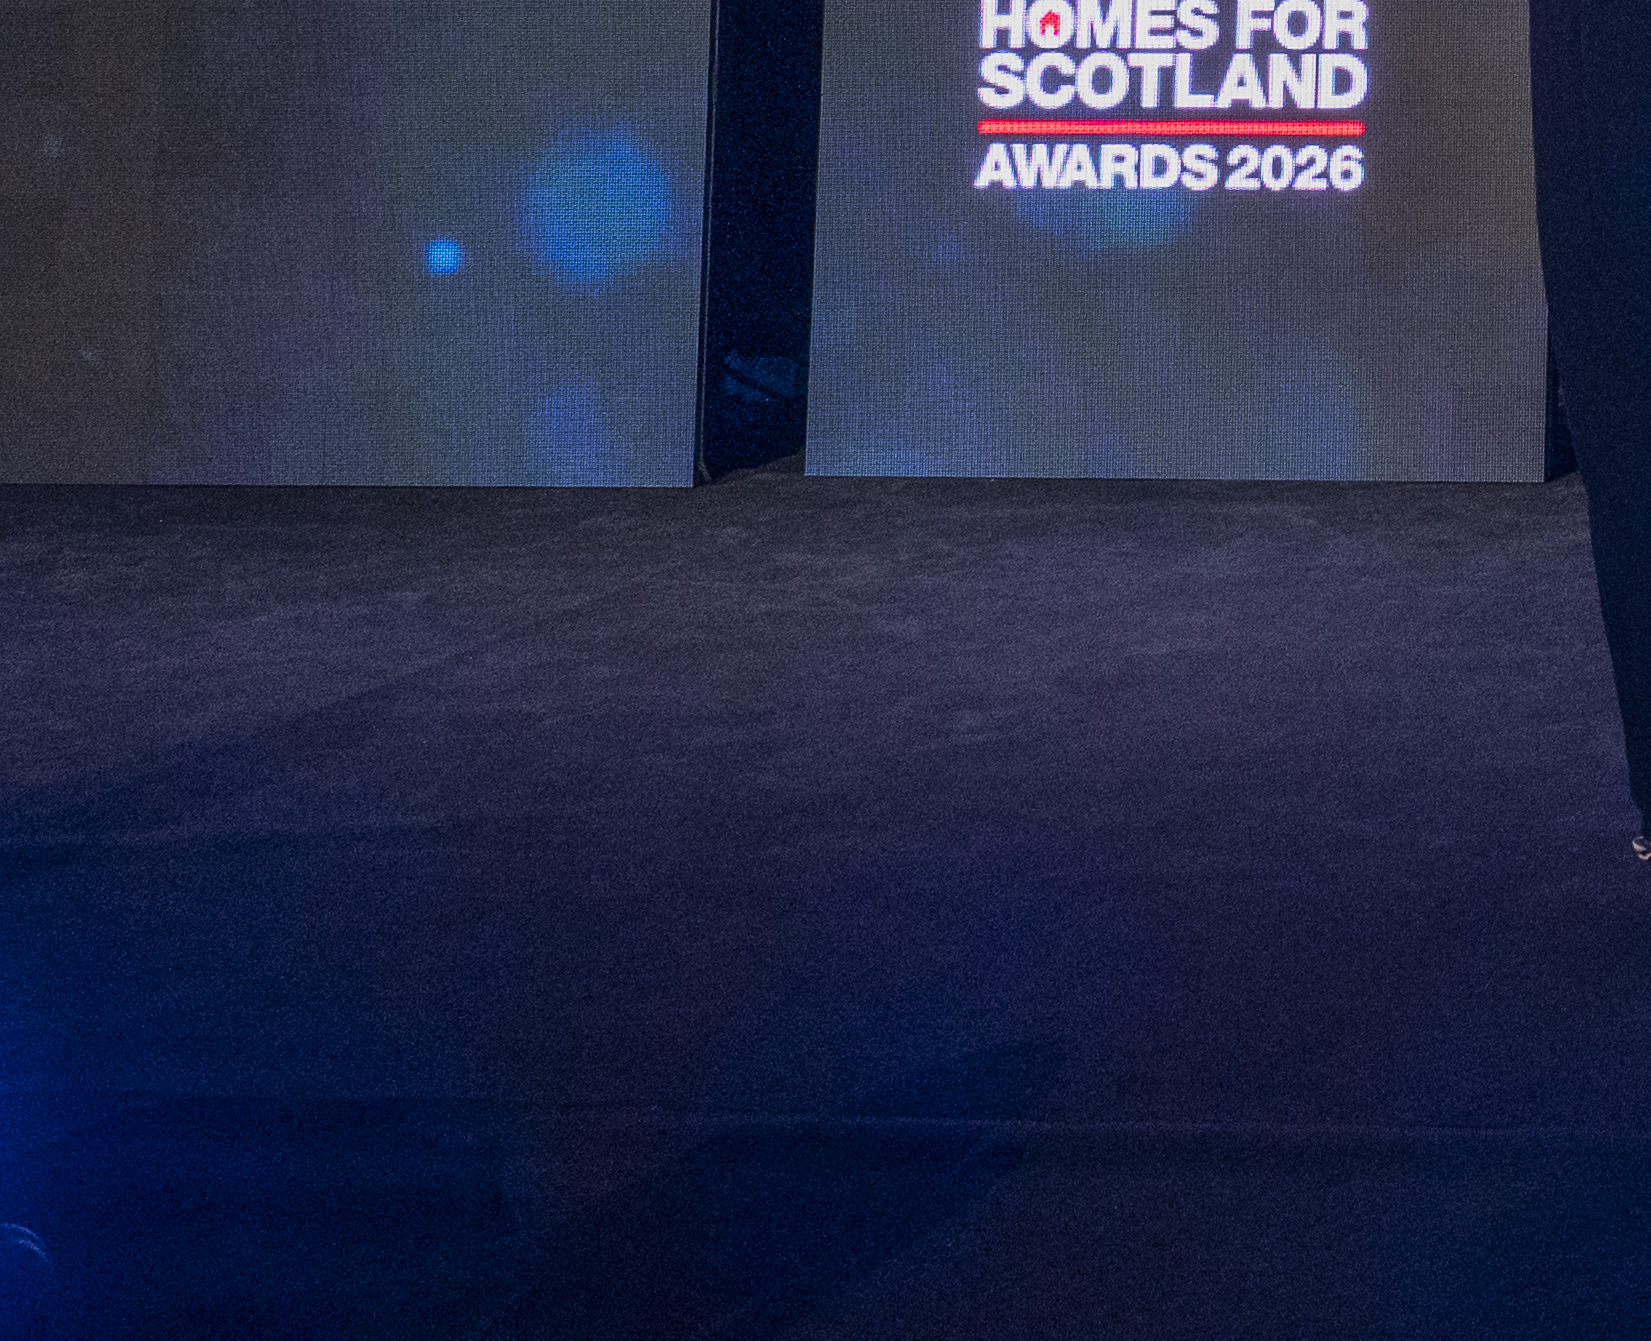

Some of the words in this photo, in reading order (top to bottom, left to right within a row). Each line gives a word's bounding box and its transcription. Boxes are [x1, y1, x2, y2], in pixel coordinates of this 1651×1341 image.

[977, 51, 1369, 110] SCOTLAND
[974, 143, 1219, 190] AWARDS
[1224, 145, 1365, 191] 2026
